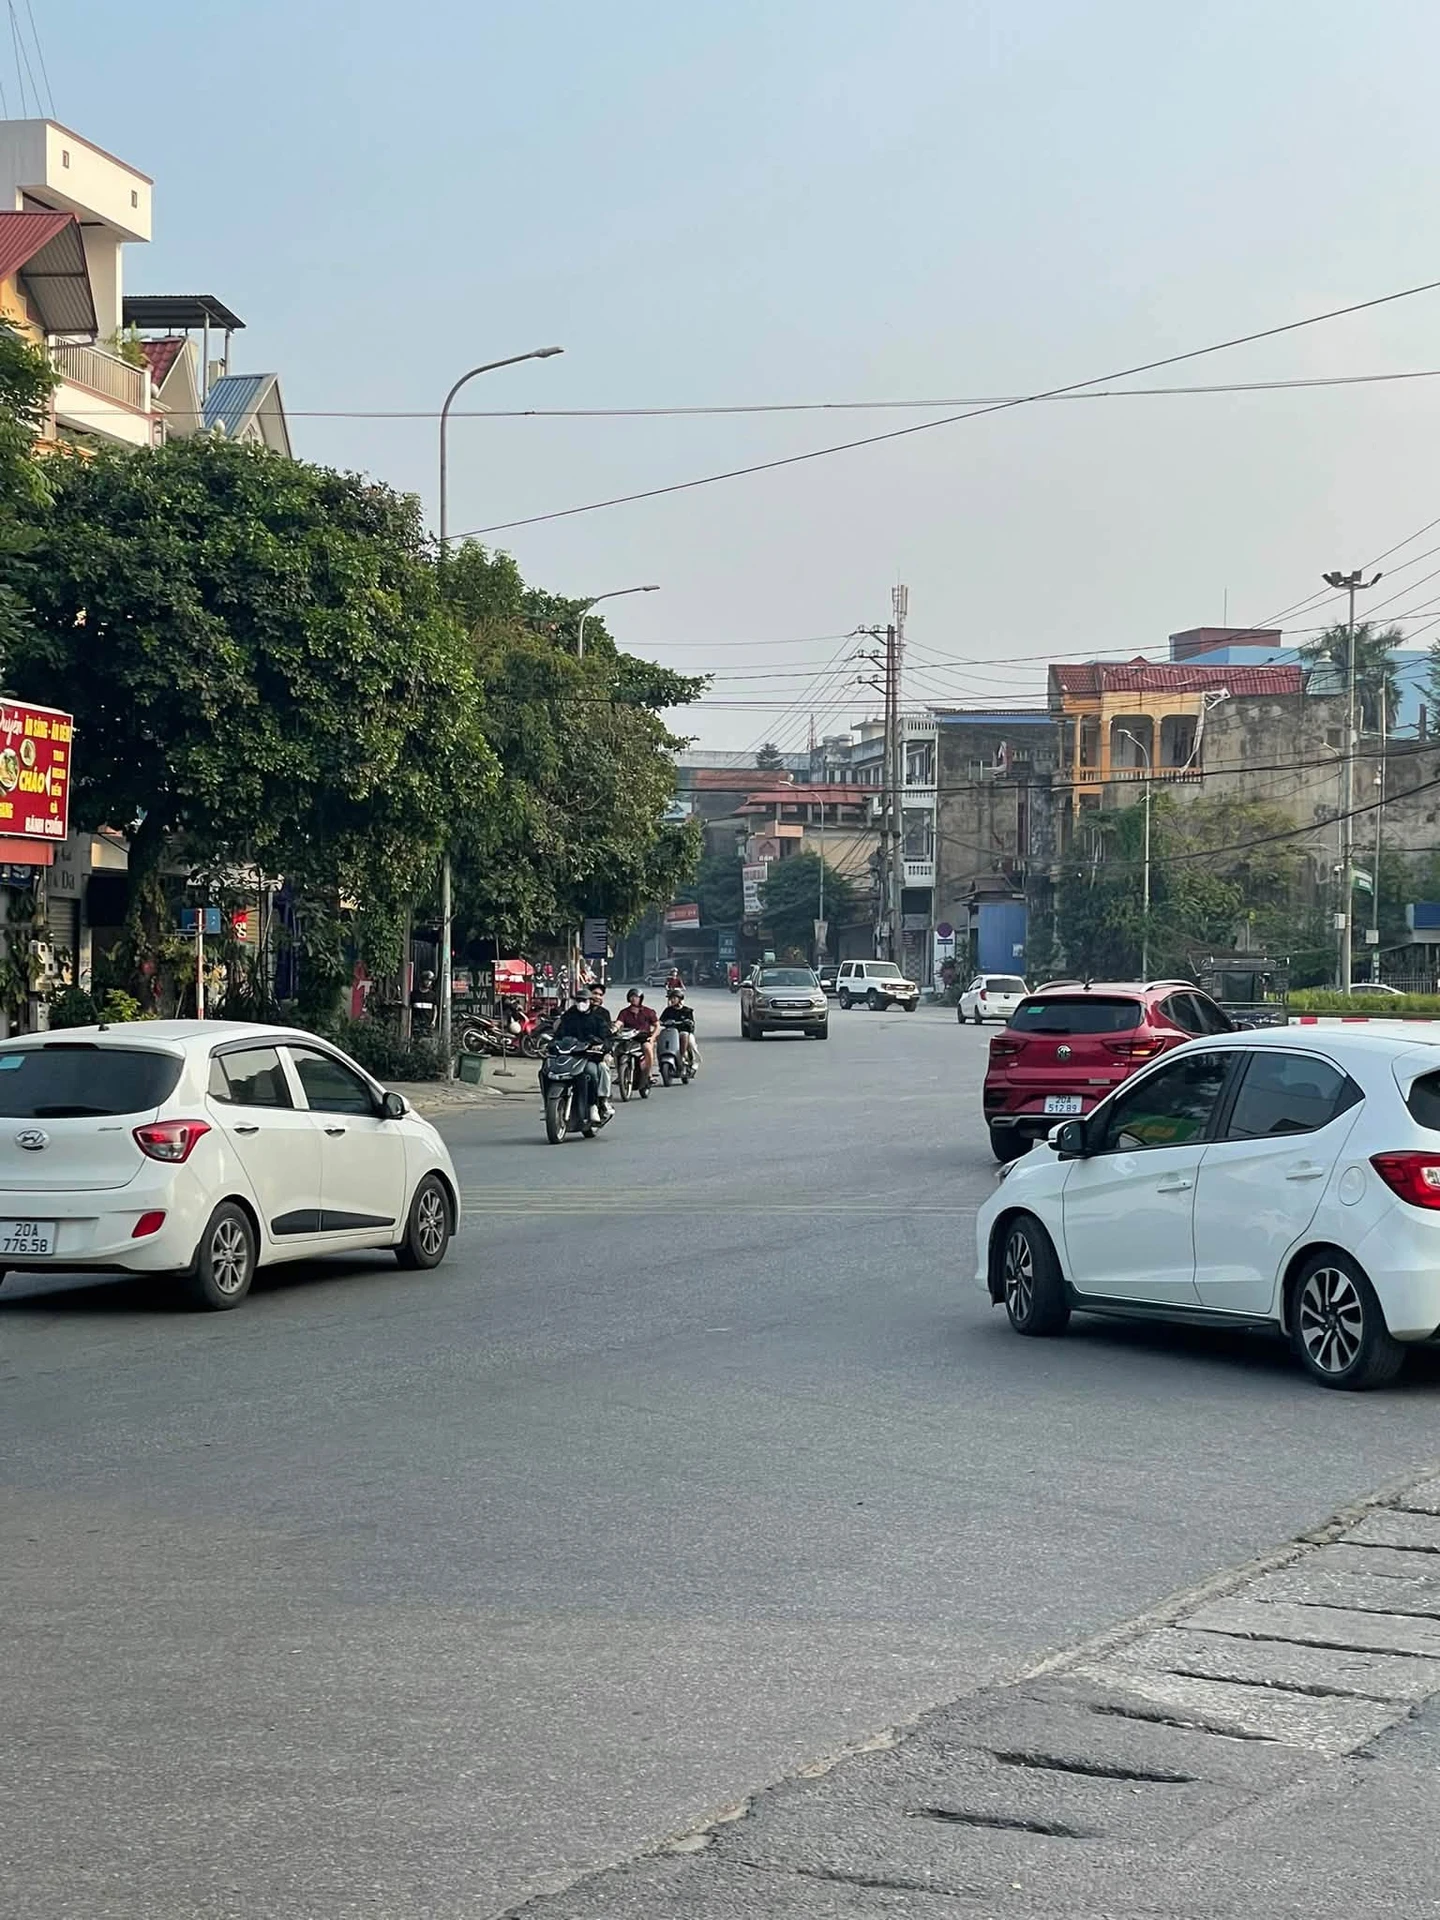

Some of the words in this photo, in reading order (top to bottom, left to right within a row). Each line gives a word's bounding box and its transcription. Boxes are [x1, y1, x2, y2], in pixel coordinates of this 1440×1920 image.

[19, 766, 45, 794] CHÁO
[25, 814, 45, 833] BÁNH
[44, 815, 64, 836] CUỐN
[477, 971, 493, 987] XE
[1055, 1095, 1072, 1104] 20A
[14, 1223, 39, 1237] 20A
[3, 1238, 49, 1253] 776.58
